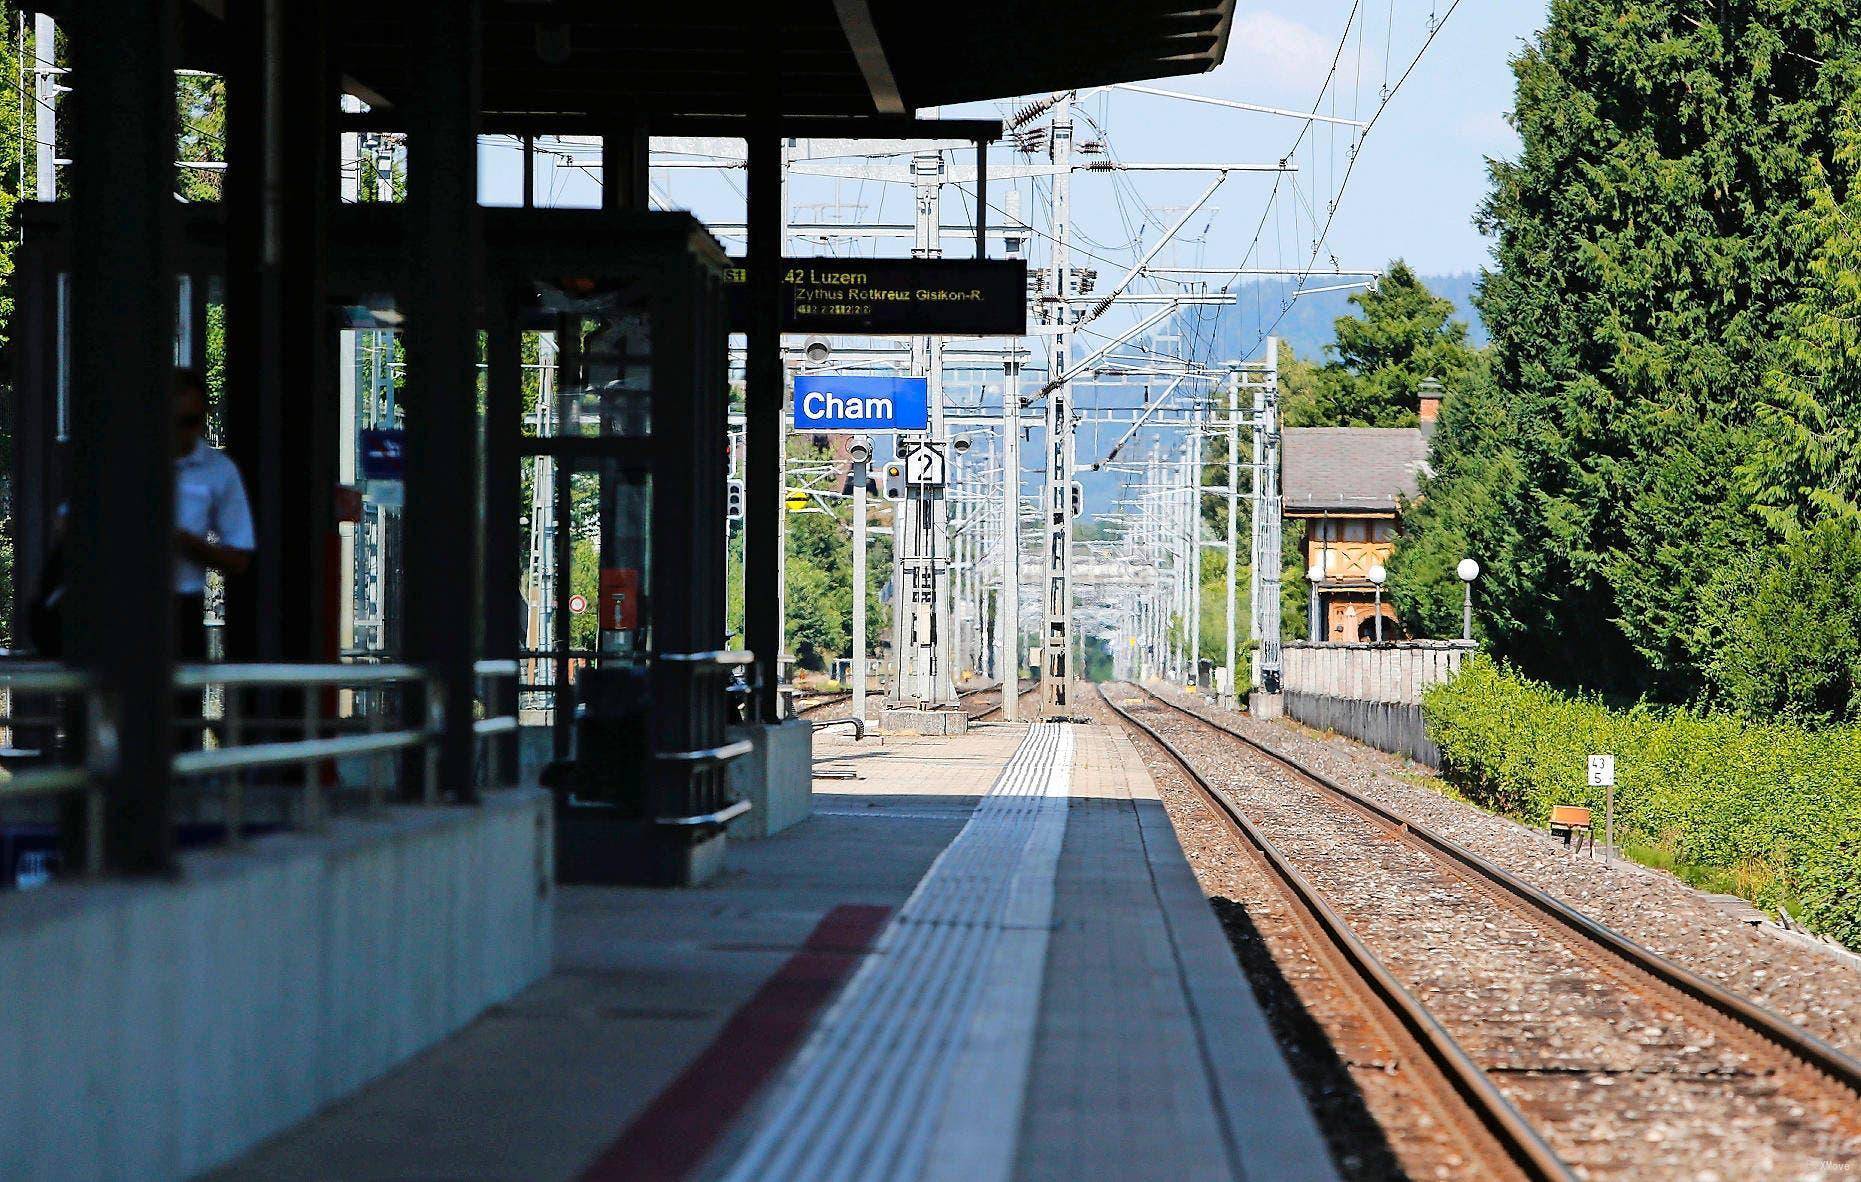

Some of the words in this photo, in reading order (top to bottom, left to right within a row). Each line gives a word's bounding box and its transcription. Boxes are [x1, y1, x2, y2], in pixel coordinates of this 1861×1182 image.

[810, 269, 867, 284] Luzern
[796, 288, 844, 301] Zythus
[848, 288, 910, 301] Rotkreuz
[803, 392, 893, 420] Cham
[917, 454, 933, 481] 2
[1592, 757, 1605, 770] 43
[1594, 772, 1602, 784] 5
